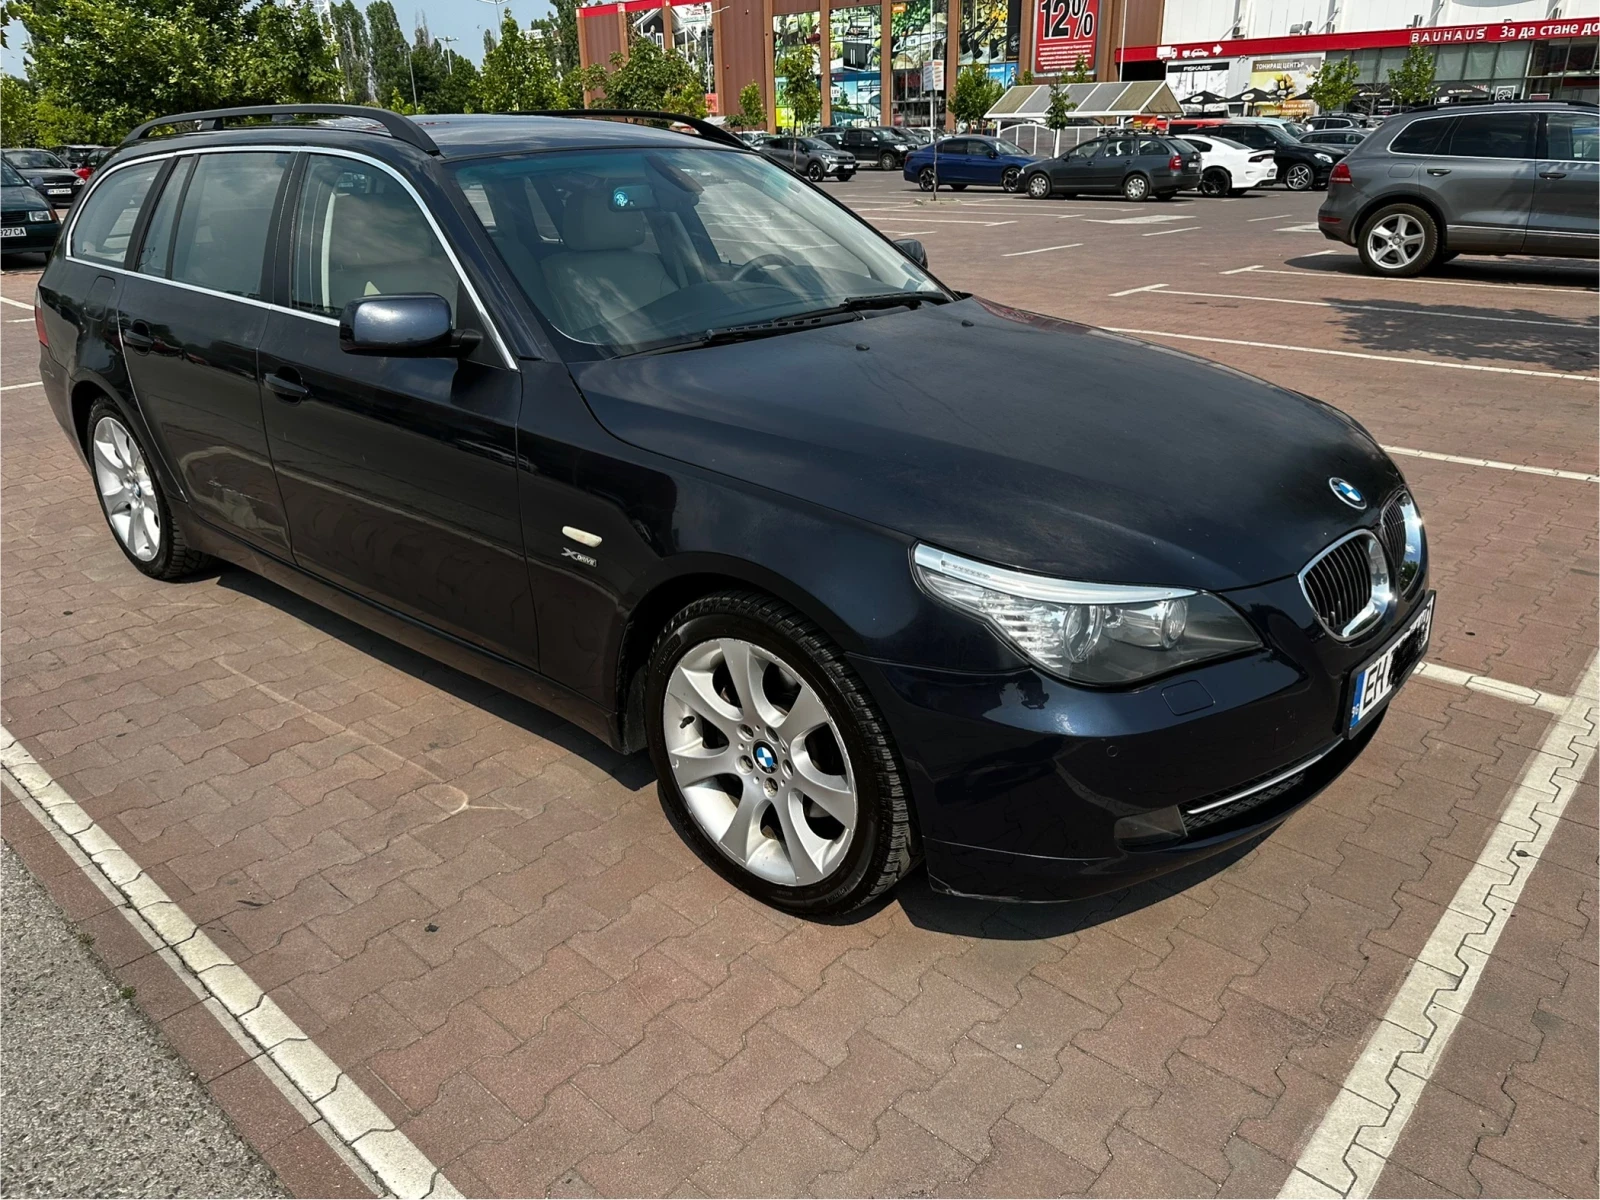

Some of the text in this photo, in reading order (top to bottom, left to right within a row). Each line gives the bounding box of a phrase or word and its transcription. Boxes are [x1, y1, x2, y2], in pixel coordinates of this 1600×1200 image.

[1040, 0, 1095, 40] 12%
[1411, 28, 1486, 43] BAUHAUS
[1499, 25, 1516, 38] За
[1518, 25, 1535, 39] да
[1540, 23, 1579, 36] стане
